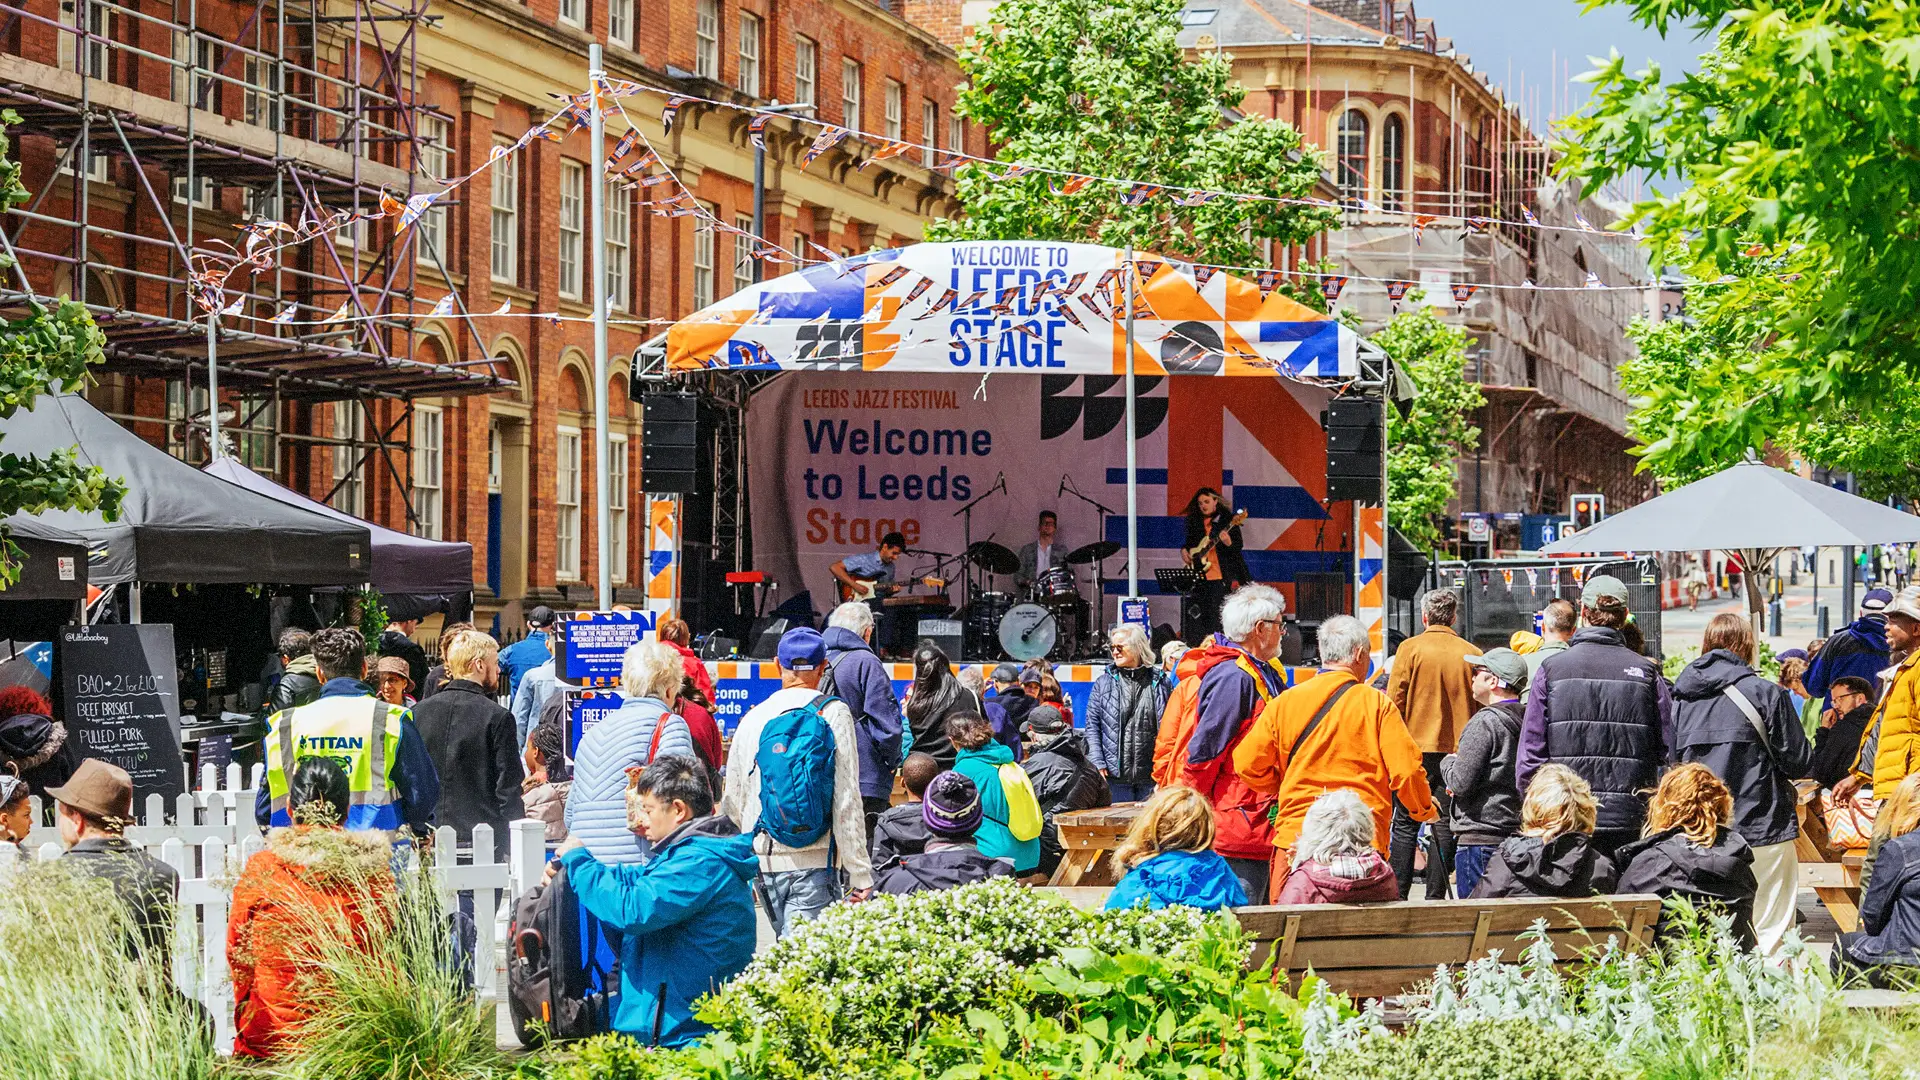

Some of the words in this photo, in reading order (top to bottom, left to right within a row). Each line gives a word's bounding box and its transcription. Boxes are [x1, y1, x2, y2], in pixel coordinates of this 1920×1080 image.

[952, 246, 1040, 267] WELCOME
[1046, 247, 1068, 267] TO
[950, 268, 1067, 318] LEEDS
[949, 318, 1066, 368] STAGE
[803, 389, 849, 409] LEEDS
[853, 389, 889, 409] JAZZ
[892, 389, 960, 410] FESTIVAL
[803, 419, 992, 457] Welcome
[803, 467, 843, 501] to
[858, 464, 972, 501] Leeds
[77, 674, 104, 694] BAO
[112, 674, 124, 692] 2
[76, 702, 100, 717] BEEF
[101, 701, 134, 716] BRISKET
[582, 708, 600, 722] FREE
[79, 729, 115, 745] PULLED
[119, 727, 144, 741] PORK
[308, 737, 363, 749] TITAN
